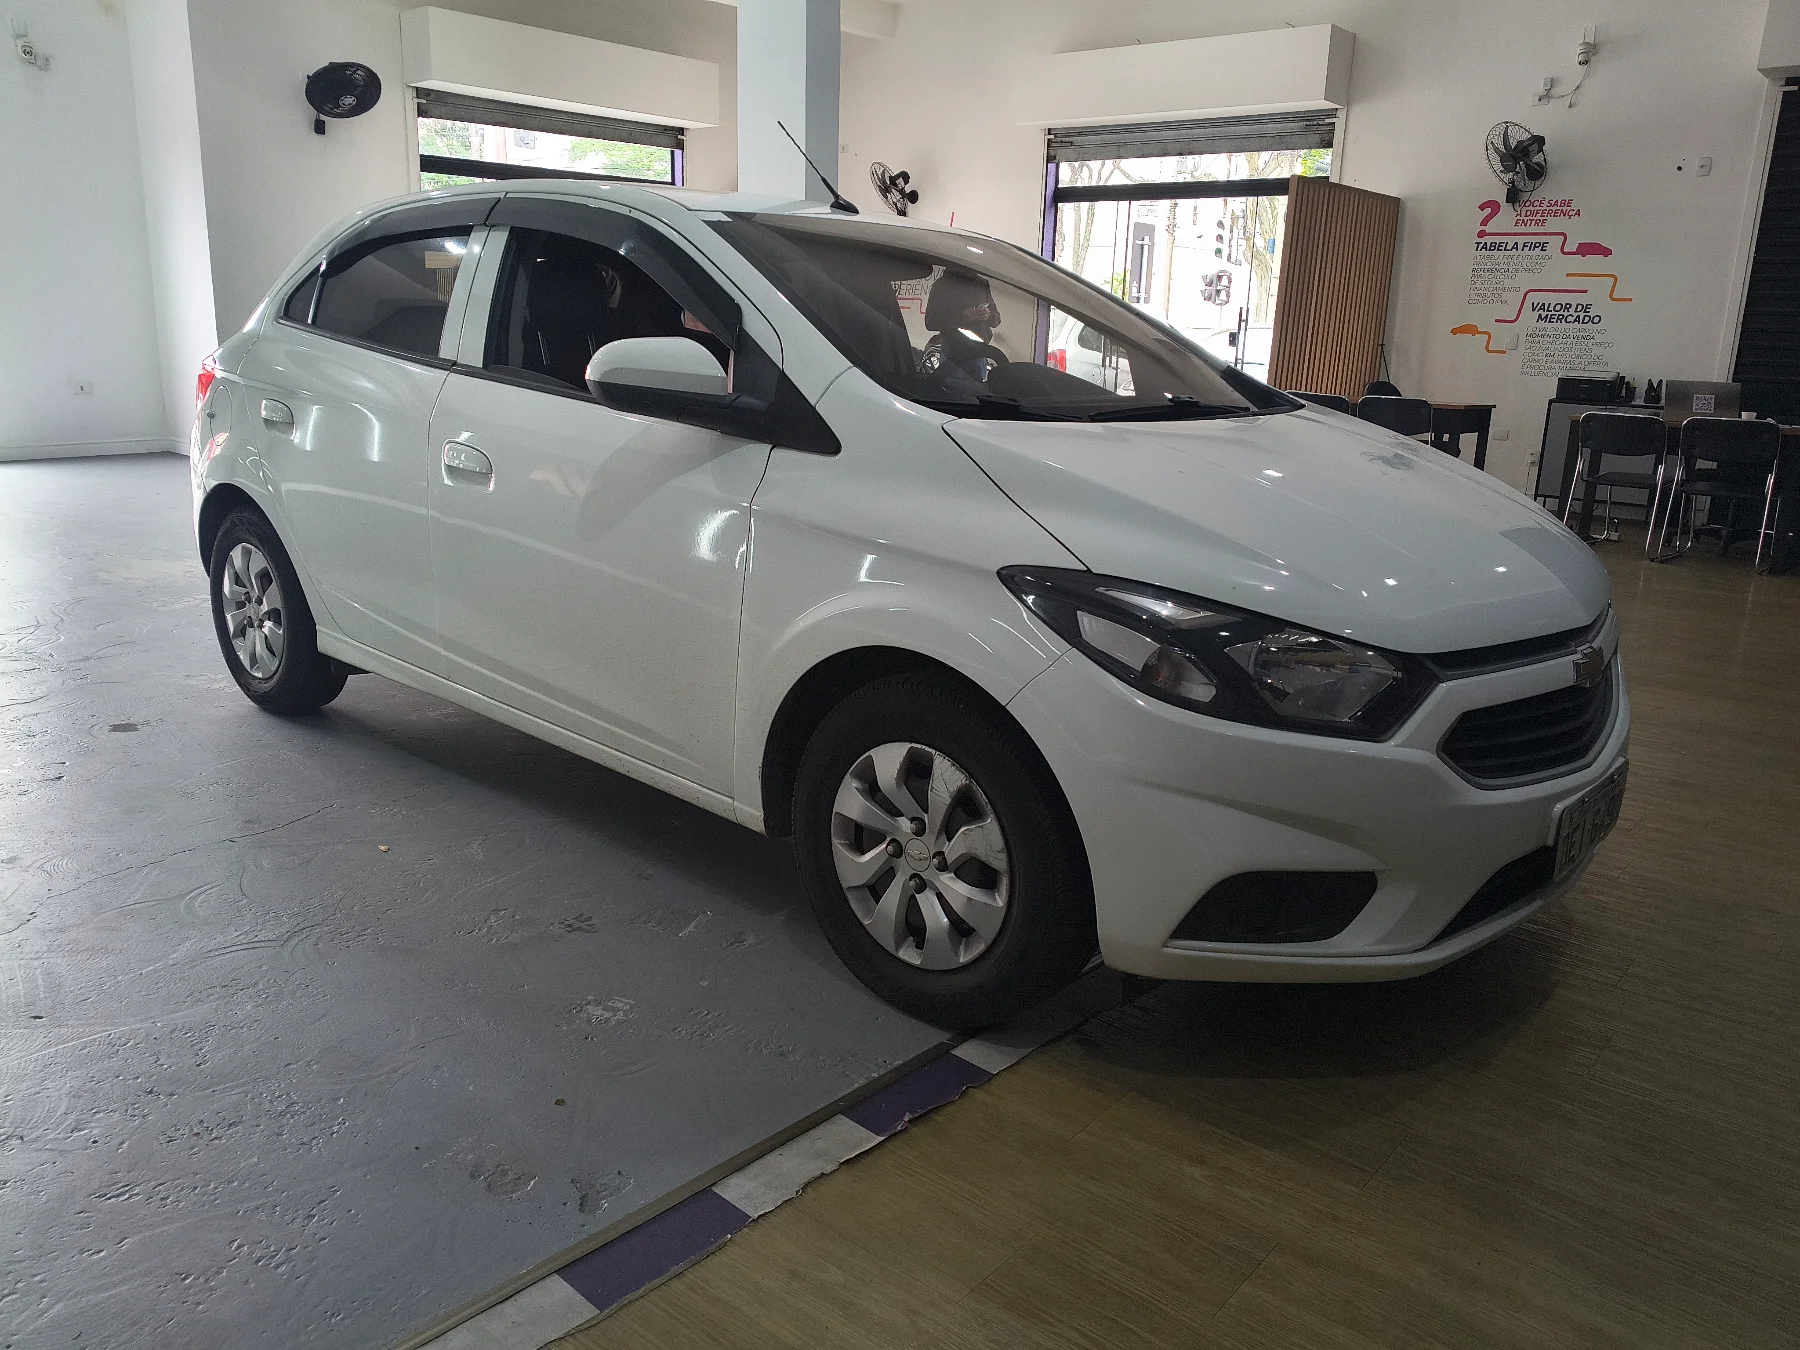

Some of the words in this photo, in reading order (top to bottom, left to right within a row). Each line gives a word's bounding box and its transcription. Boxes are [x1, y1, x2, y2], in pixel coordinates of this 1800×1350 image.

[1518, 197, 1546, 208] VOCÊ
[1547, 199, 1573, 208] SABE
[1524, 209, 1581, 219] DIFERENÇA
[1514, 219, 1547, 227] ENTRE
[1474, 242, 1519, 252] TABELA
[1521, 242, 1549, 252] FIPE
[1531, 302, 1572, 313] VALOR
[1574, 303, 1593, 314] DE
[1536, 314, 1602, 325] MERCADO
[1556, 352, 1592, 360] HISTÓRICO
